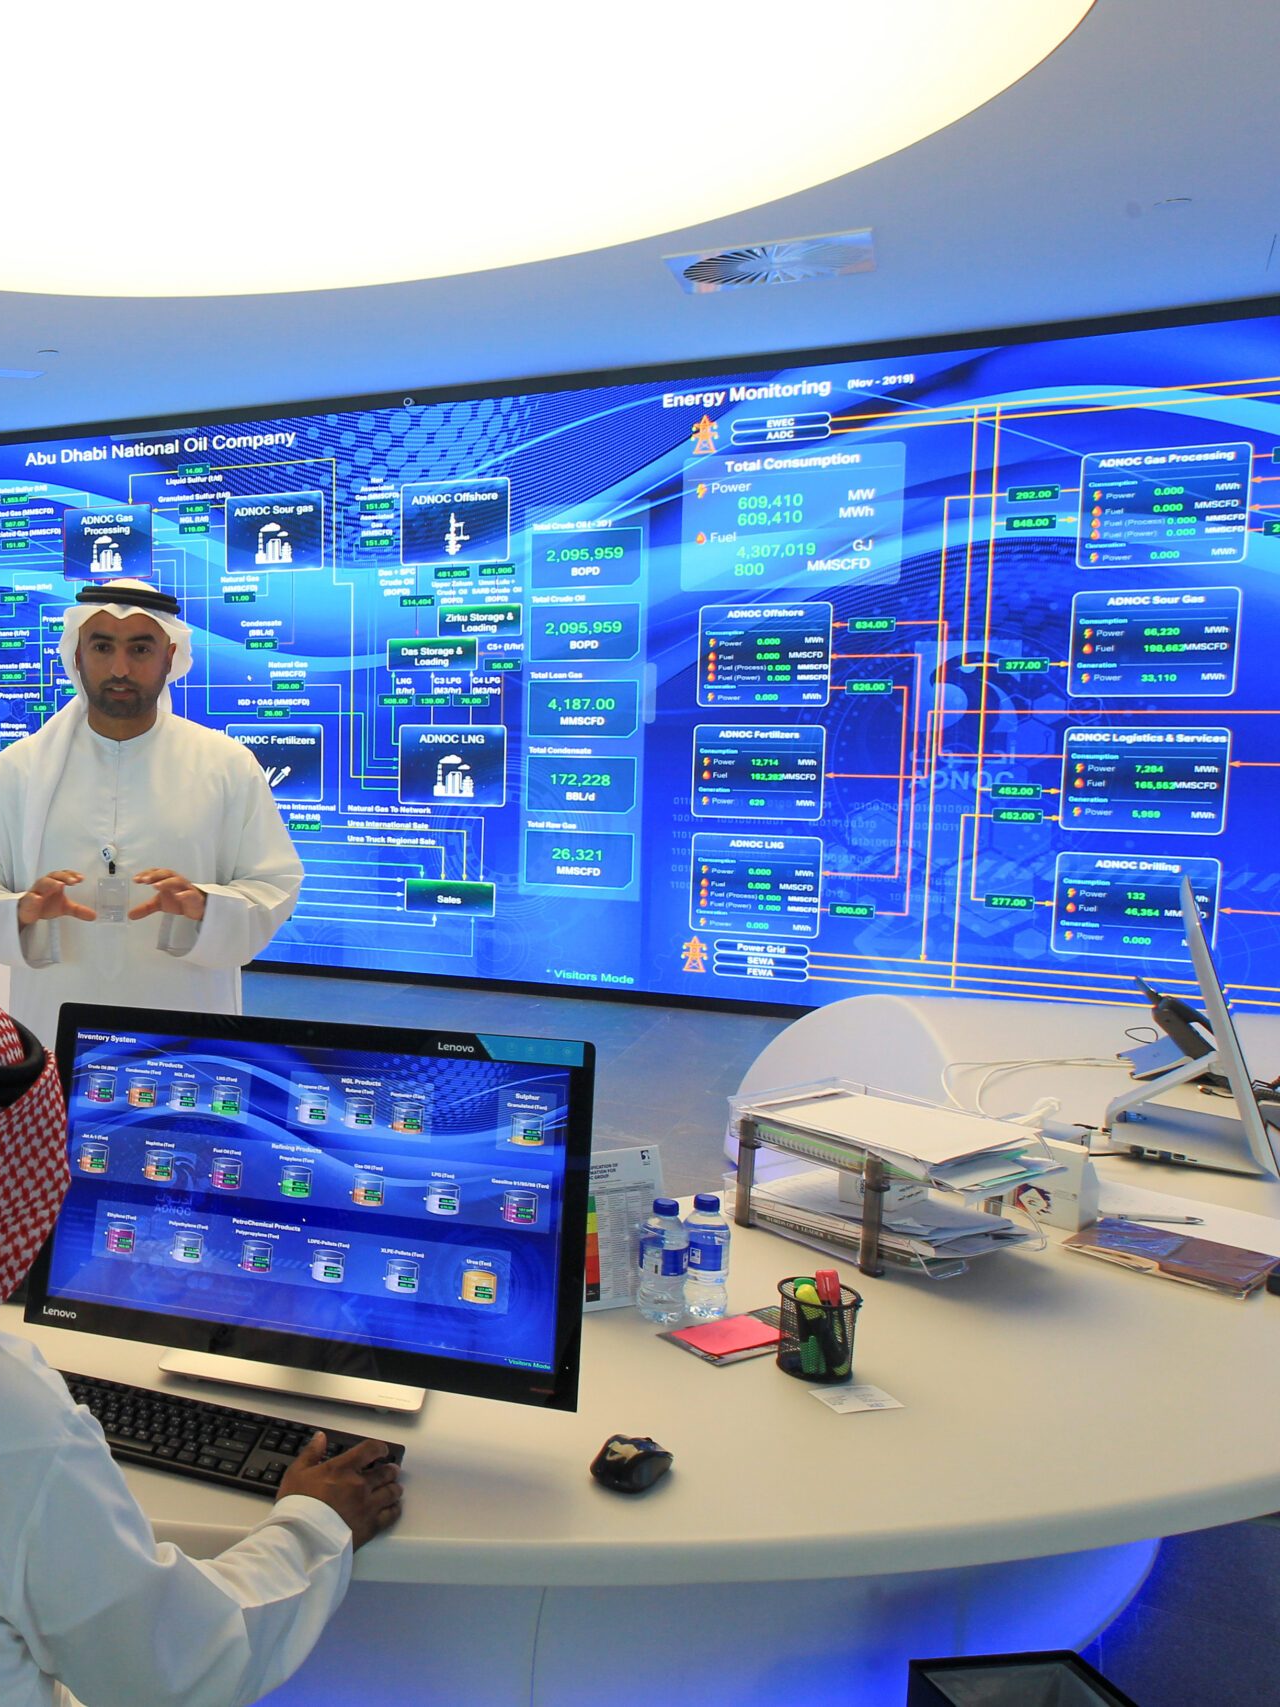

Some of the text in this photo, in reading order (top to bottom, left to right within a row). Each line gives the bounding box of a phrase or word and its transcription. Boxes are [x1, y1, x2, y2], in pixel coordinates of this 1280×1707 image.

[662, 374, 914, 408] Energy Monitoring (Nov 2019)
[767, 418, 795, 427] EWEC
[766, 431, 794, 440] AADC
[26, 430, 296, 467] Abu Dhabi National Oil Company
[725, 453, 860, 472] Total Consumption
[1099, 450, 1236, 468] ADNOC Gas Processing
[712, 481, 751, 494] Power
[412, 491, 498, 505] ADNOC Offshore
[738, 489, 875, 510] 609,410 MW
[234, 504, 314, 517] ADNOC Sour gas
[81, 514, 133, 525] ADNOC Gas
[737, 507, 874, 527] 609,410 MWh
[84, 525, 130, 536] Processing
[710, 532, 736, 542] Fuel
[736, 540, 873, 559] 4,307,019 GJ
[546, 547, 624, 563] 2,095,959
[571, 566, 600, 576] BOPD
[734, 558, 870, 576] 800 MMSCFD
[1108, 595, 1205, 606] ADNOC Sour Gas
[445, 612, 514, 623] Zirku Storage &
[727, 608, 804, 618] ADNOC Offshore
[462, 623, 497, 634] Loading
[545, 621, 622, 636] 2,095,959
[855, 620, 888, 629] 634.00
[1204, 626, 1229, 634] MWh
[569, 639, 598, 649] BOPD
[757, 636, 824, 646] 0.000 MWh
[401, 646, 463, 658] Das Storage &
[756, 652, 780, 660] 0.000
[789, 651, 823, 659] MMSCFD
[415, 656, 449, 667] Loading
[1006, 661, 1041, 670] 377.00
[530, 671, 546, 679] Total
[549, 671, 566, 679] Lean
[1141, 674, 1176, 683] 33,110
[548, 698, 615, 711] 4,187.00
[560, 716, 605, 726] MMSCFD
[419, 735, 485, 744] ADNOC LNG
[719, 730, 800, 739] ADNOC Fertilizers
[1069, 733, 1227, 744] ADNOC Logistics & Services
[233, 736, 315, 745] ADNOC Fertilizers
[529, 746, 592, 755] Total Condensate
[713, 758, 816, 767] Power 12,714 MWh
[1088, 764, 1115, 773] Power
[1194, 765, 1218, 774] MWh
[550, 774, 611, 786] 172,228
[566, 792, 595, 801] BBL/d
[400, 806, 431, 814] Network
[730, 840, 784, 849] ADNOC LNG
[552, 848, 603, 861] 26,321
[556, 866, 600, 876] MMSCFD
[1095, 860, 1180, 874] ADNOC Drilling
[437, 895, 461, 905] Sales
[1080, 890, 1146, 900] Power 132
[992, 898, 1027, 908] 277.00
[1078, 904, 1097, 912] Fuel
[737, 943, 786, 954] Power Grid
[747, 957, 774, 965] SEWA
[554, 969, 634, 984] Visitors Mode
[747, 968, 773, 977] FEWA
[78, 1032, 136, 1044] Inventory System
[438, 1042, 474, 1053] Lenovo
[158, 1061, 183, 1069] Products
[341, 1077, 382, 1087] NGL Products
[515, 1093, 540, 1102] Sulphur
[272, 1143, 322, 1154] Refining Products
[232, 1218, 301, 1232] PetroChemical Products
[43, 1306, 76, 1319] Lenovo
[508, 1358, 532, 1368] Visitors
